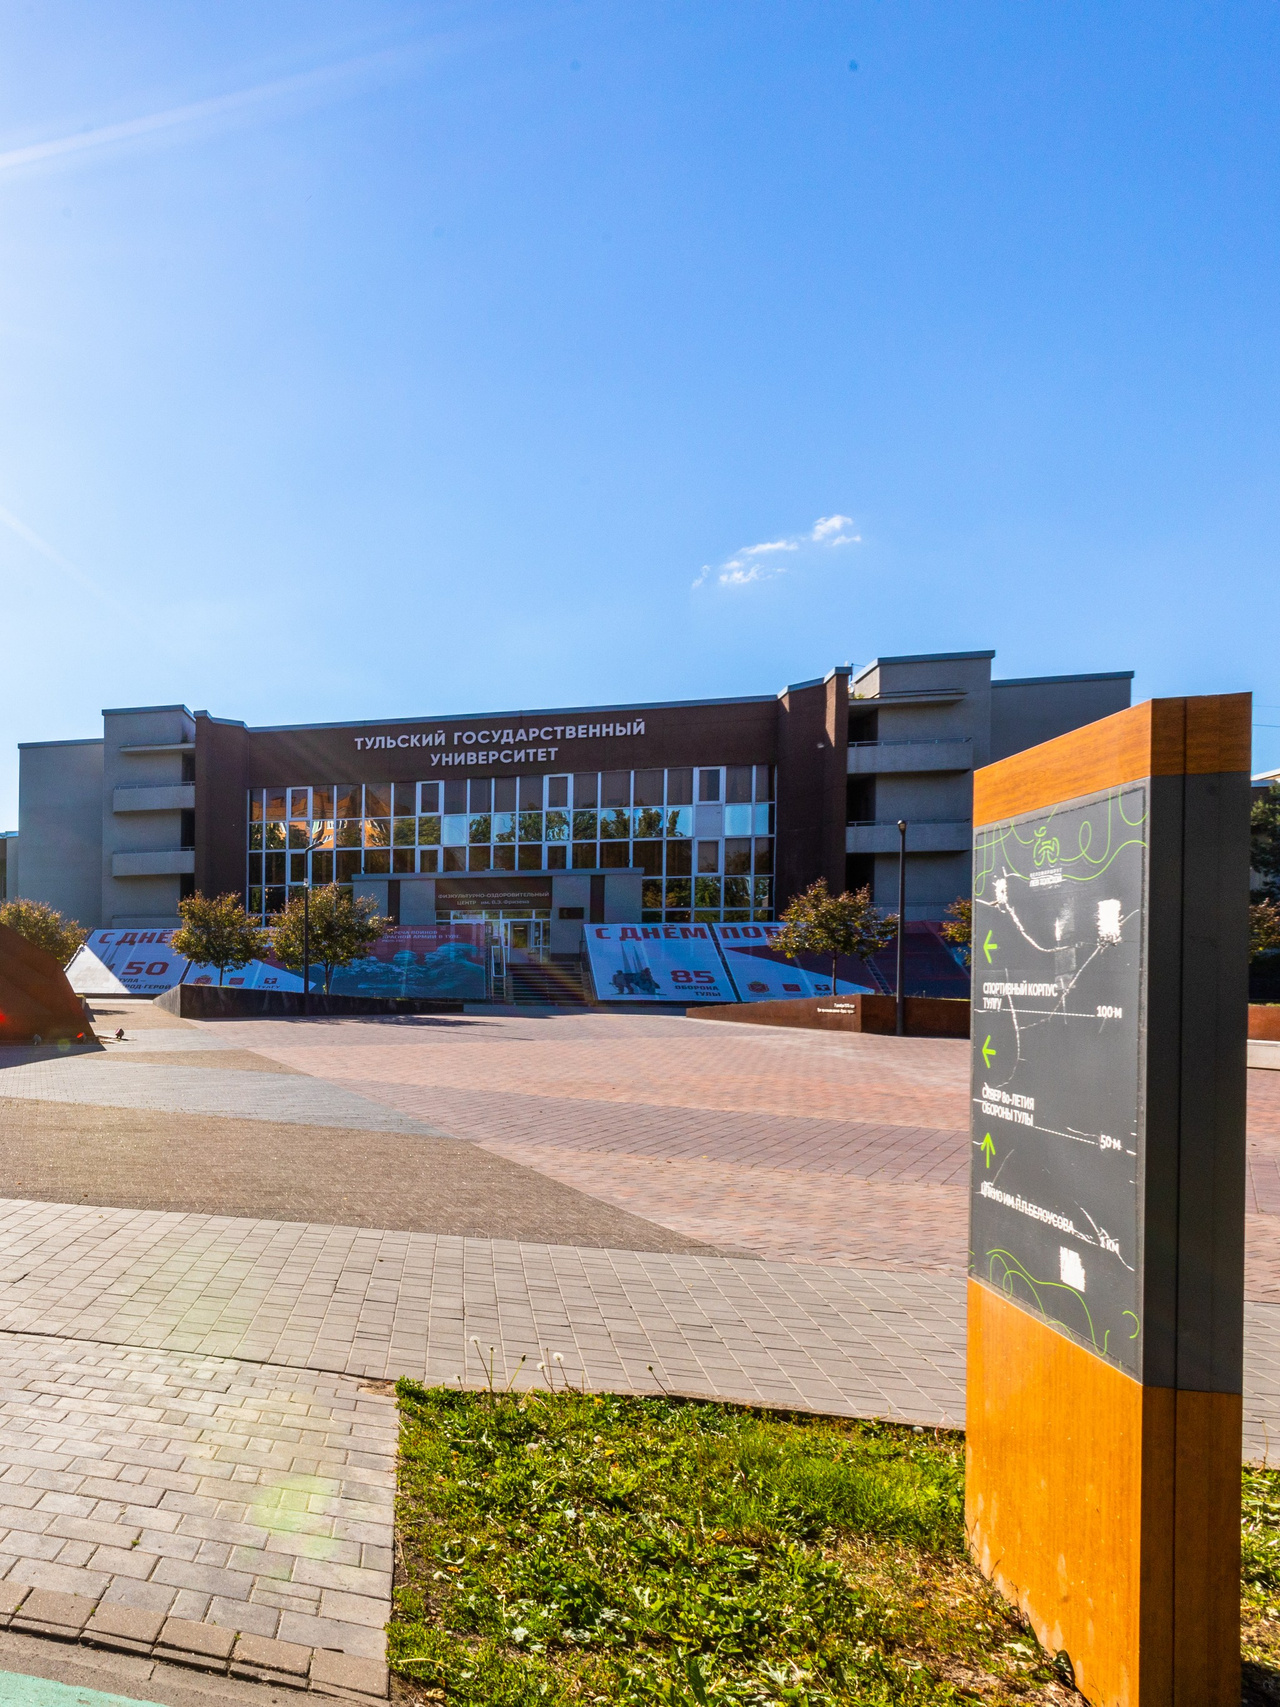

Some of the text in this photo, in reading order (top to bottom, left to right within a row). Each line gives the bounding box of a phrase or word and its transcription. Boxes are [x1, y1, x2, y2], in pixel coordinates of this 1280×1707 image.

[354, 719, 646, 750] ТУЛЬСКИЙ ГОСУДАРСТВЕННЫЙ
[430, 748, 558, 766] УНИВЕРСИТЕТ
[438, 891, 549, 899] ФИЗКУЛЬТУРНО-ОЗДОРОВИТЕЛЬНЫЙ
[99, 930, 173, 946] С ДНЁ
[595, 924, 708, 941] С ДНЁМ
[122, 962, 169, 975] 50
[670, 970, 715, 983] 85
[983, 980, 1058, 997] СПОРТИВНЫЙ КОРПУС
[983, 997, 1002, 1010] ТУЛГУ
[1097, 1005, 1113, 1018] 100
[982, 1086, 1034, 1110] СКВЕР 80-ЛЕТИЯ
[982, 1102, 1034, 1126] ОБОРОНЫ ТУЛЫ
[1100, 1135, 1112, 1149] 50
